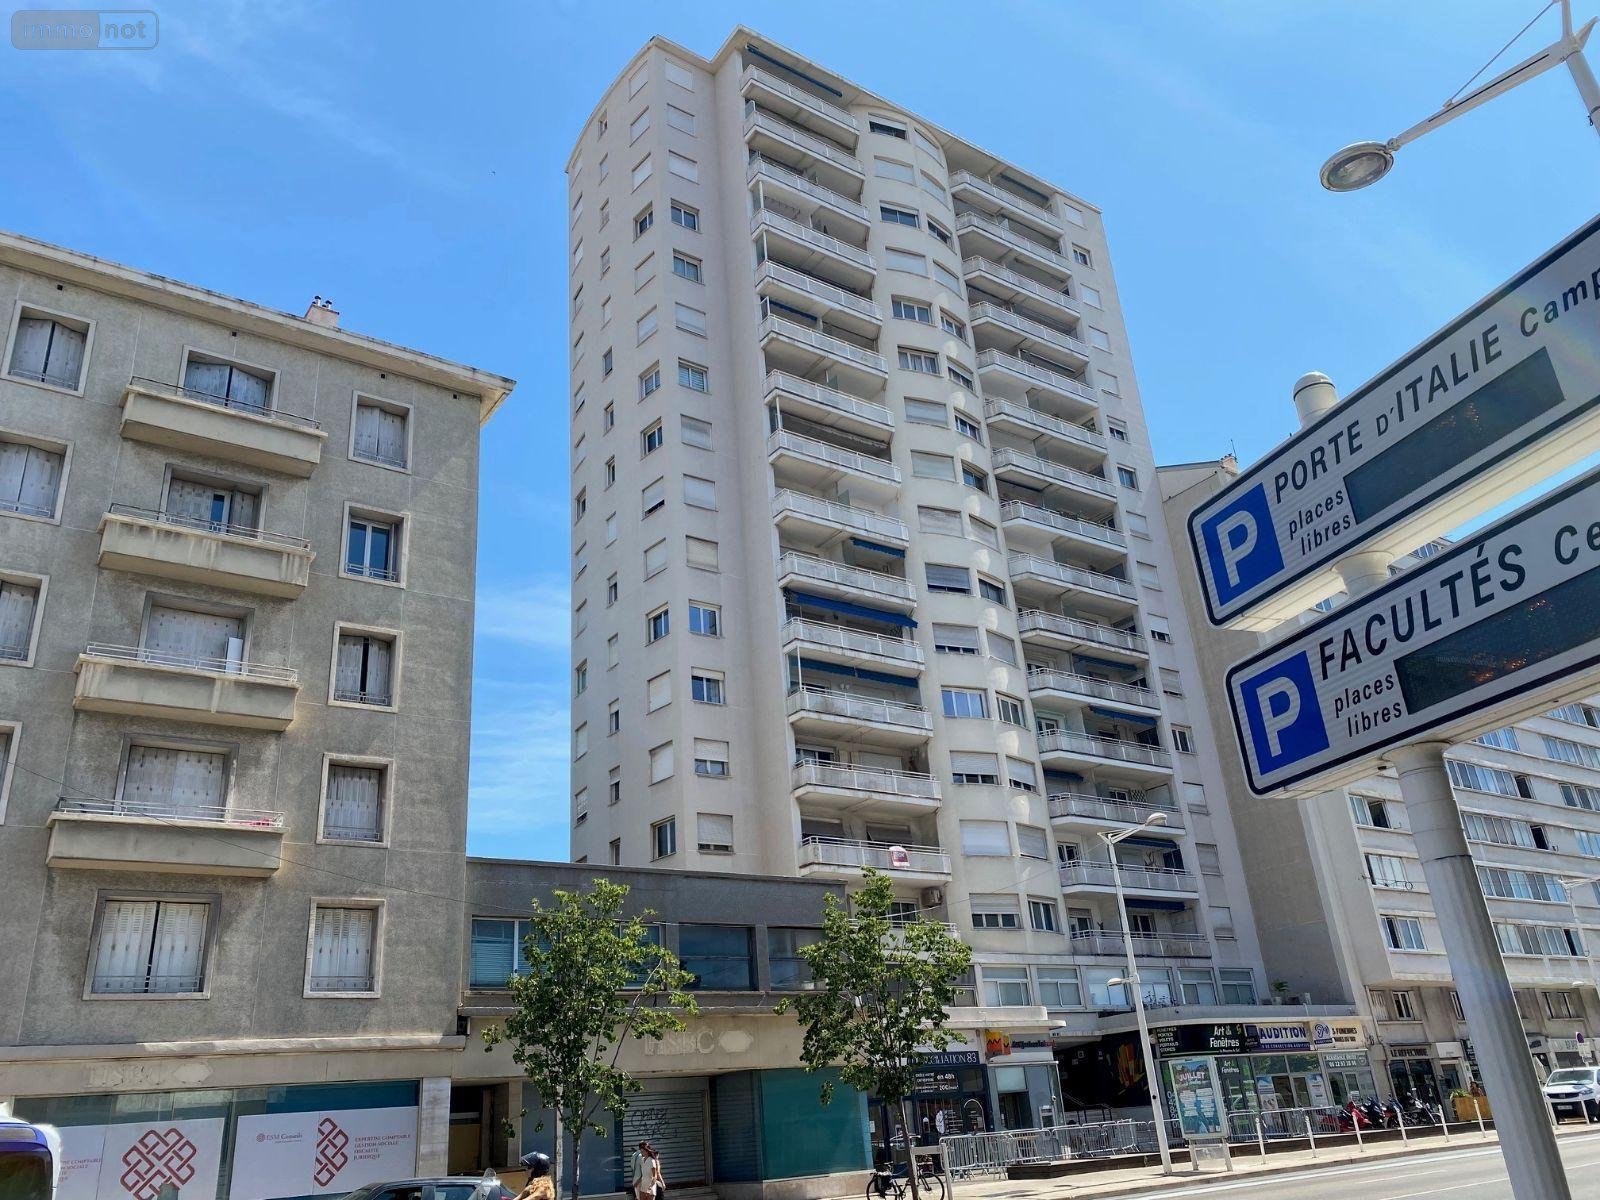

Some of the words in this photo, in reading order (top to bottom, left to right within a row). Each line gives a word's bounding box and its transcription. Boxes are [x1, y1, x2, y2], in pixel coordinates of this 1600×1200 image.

[1275, 420, 1363, 504] PORTE
[1289, 489, 1344, 540] places
[1216, 510, 1258, 588] P
[1301, 515, 1351, 555] libres
[1319, 543, 1526, 680] FACULTÉS
[1334, 674, 1395, 718] places
[1256, 676, 1301, 758] P
[1347, 702, 1402, 738] libres
[1209, 1037, 1240, 1048] Fenêtres
[1214, 1025, 1225, 1036] Art
[1260, 1027, 1307, 1039] AUDITION
[967, 1052, 977, 1063] 83
[1180, 1071, 1206, 1081] JUILLET
